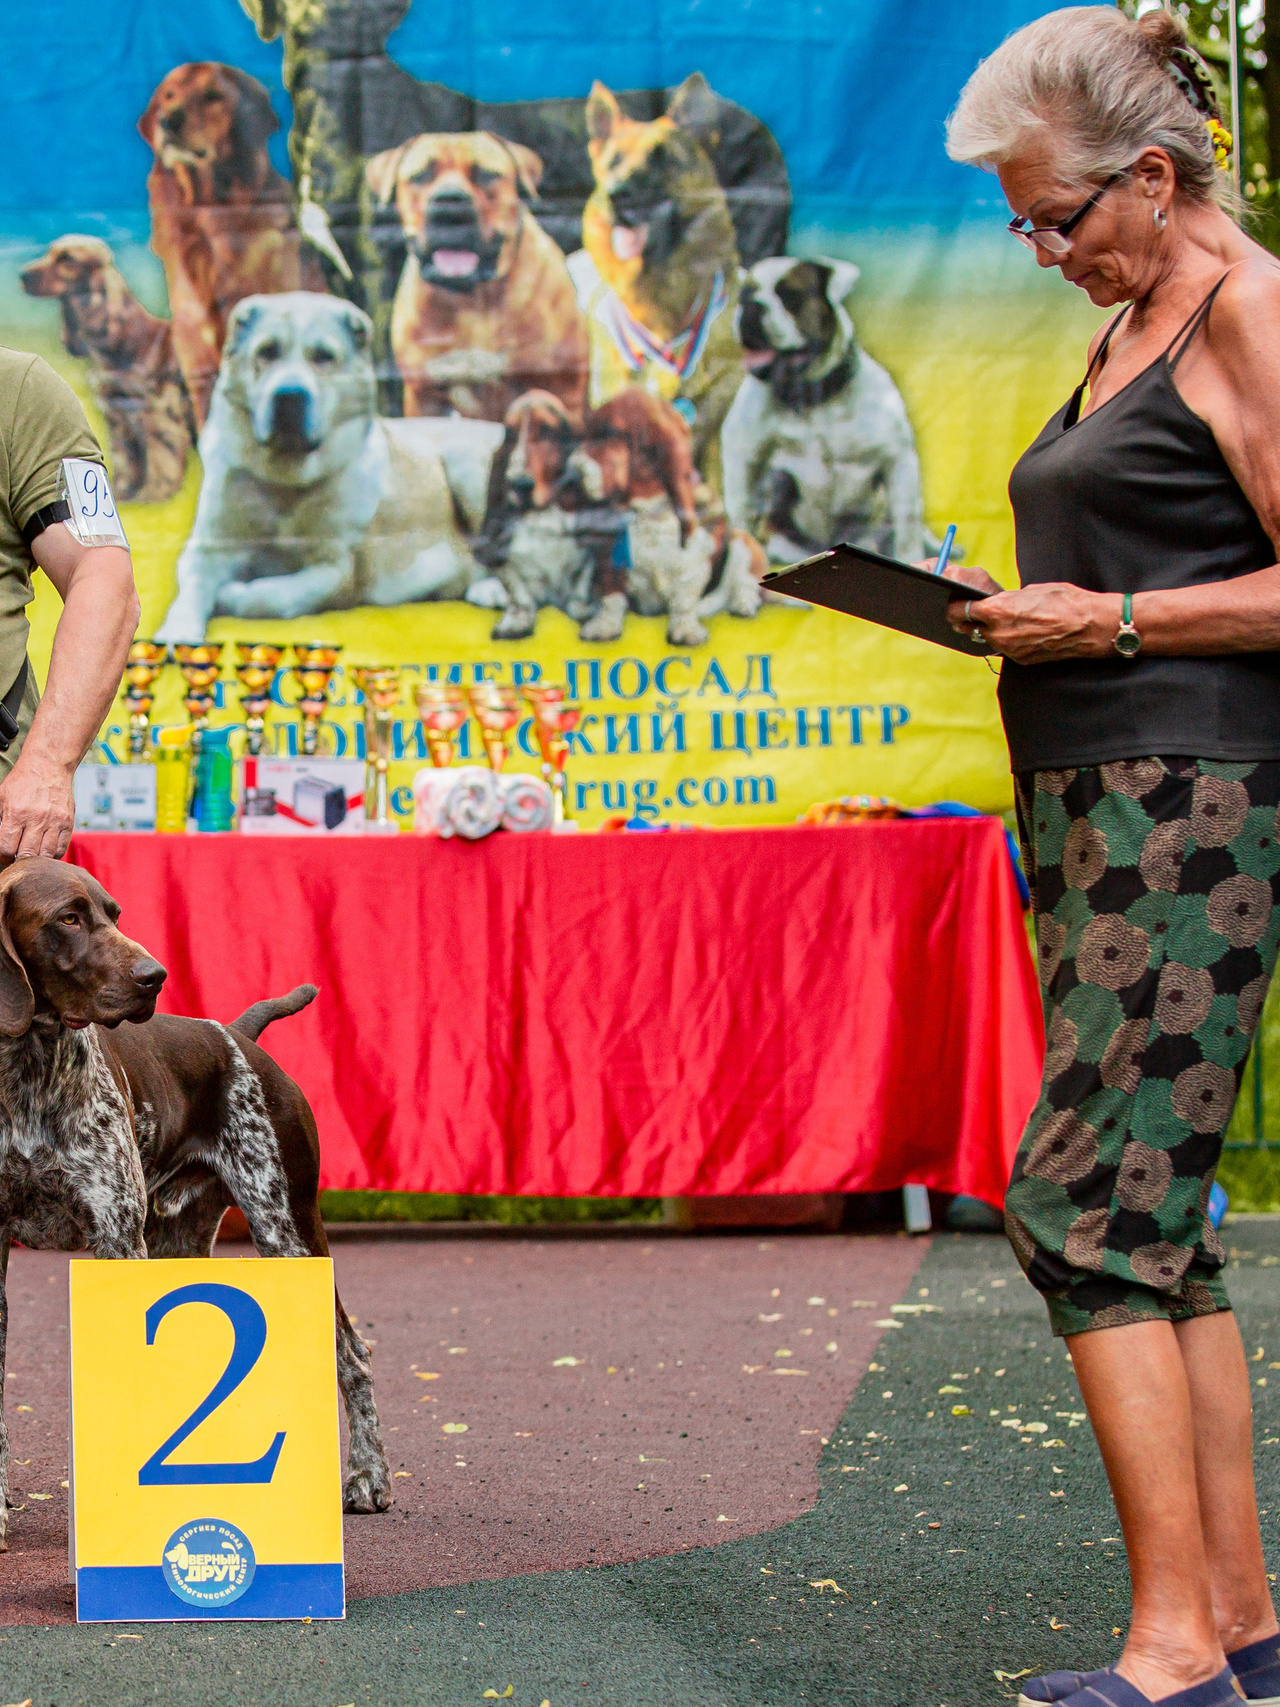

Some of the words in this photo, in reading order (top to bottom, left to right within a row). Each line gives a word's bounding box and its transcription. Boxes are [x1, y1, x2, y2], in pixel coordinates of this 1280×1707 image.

[565, 654, 777, 701] ПОСАД
[710, 704, 911, 756] ЦЕНТР
[138, 1282, 287, 1486] 2
[179, 1525, 216, 1542] СЕРГИЕВ
[219, 1527, 244, 1550] ПОСАД
[170, 1563, 237, 1600] КИНОЛОГИЧЕСКИЙ
[235, 1557, 248, 1585] ЦЕНТР
[184, 1565, 240, 1582] ДРУГ
